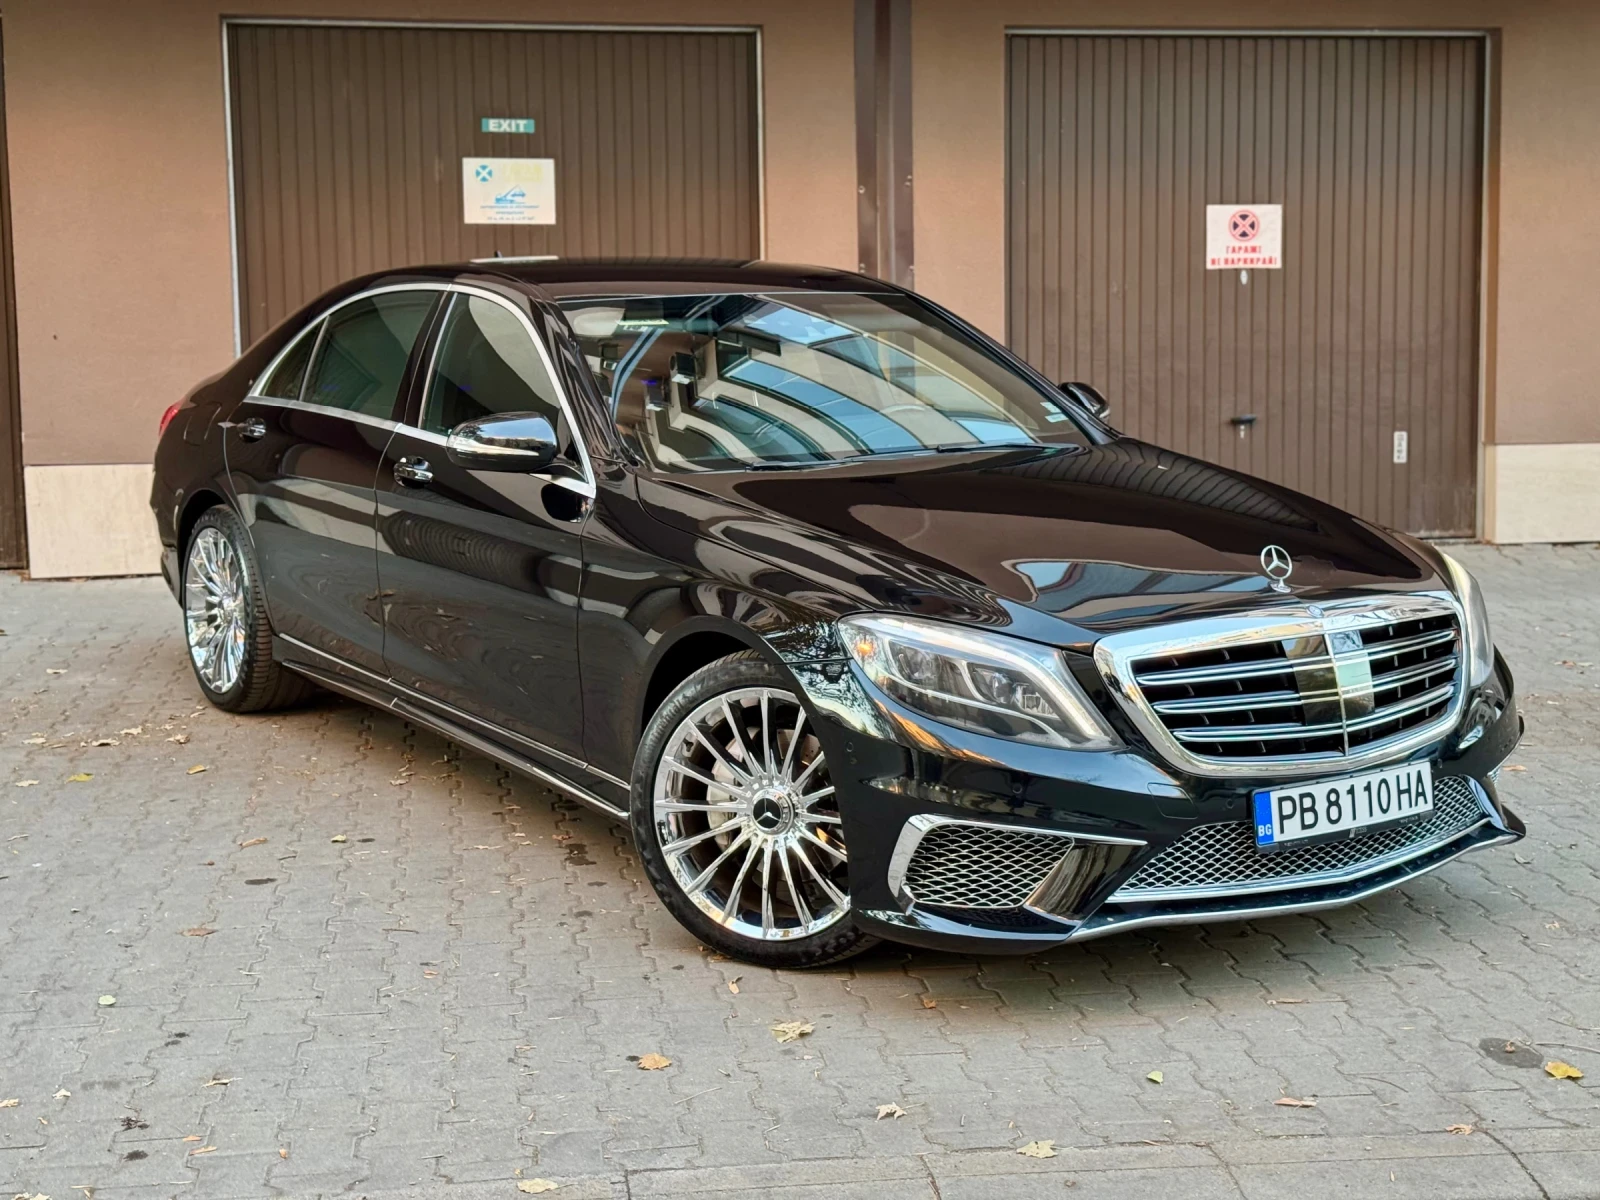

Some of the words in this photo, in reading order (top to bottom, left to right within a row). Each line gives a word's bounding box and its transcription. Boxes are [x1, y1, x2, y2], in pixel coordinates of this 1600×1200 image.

[488, 119, 528, 133] EXIT
[1277, 792, 1318, 834] PB
[1326, 778, 1391, 825] 8110
[1396, 770, 1428, 811] HA
[1258, 824, 1272, 837] BG
